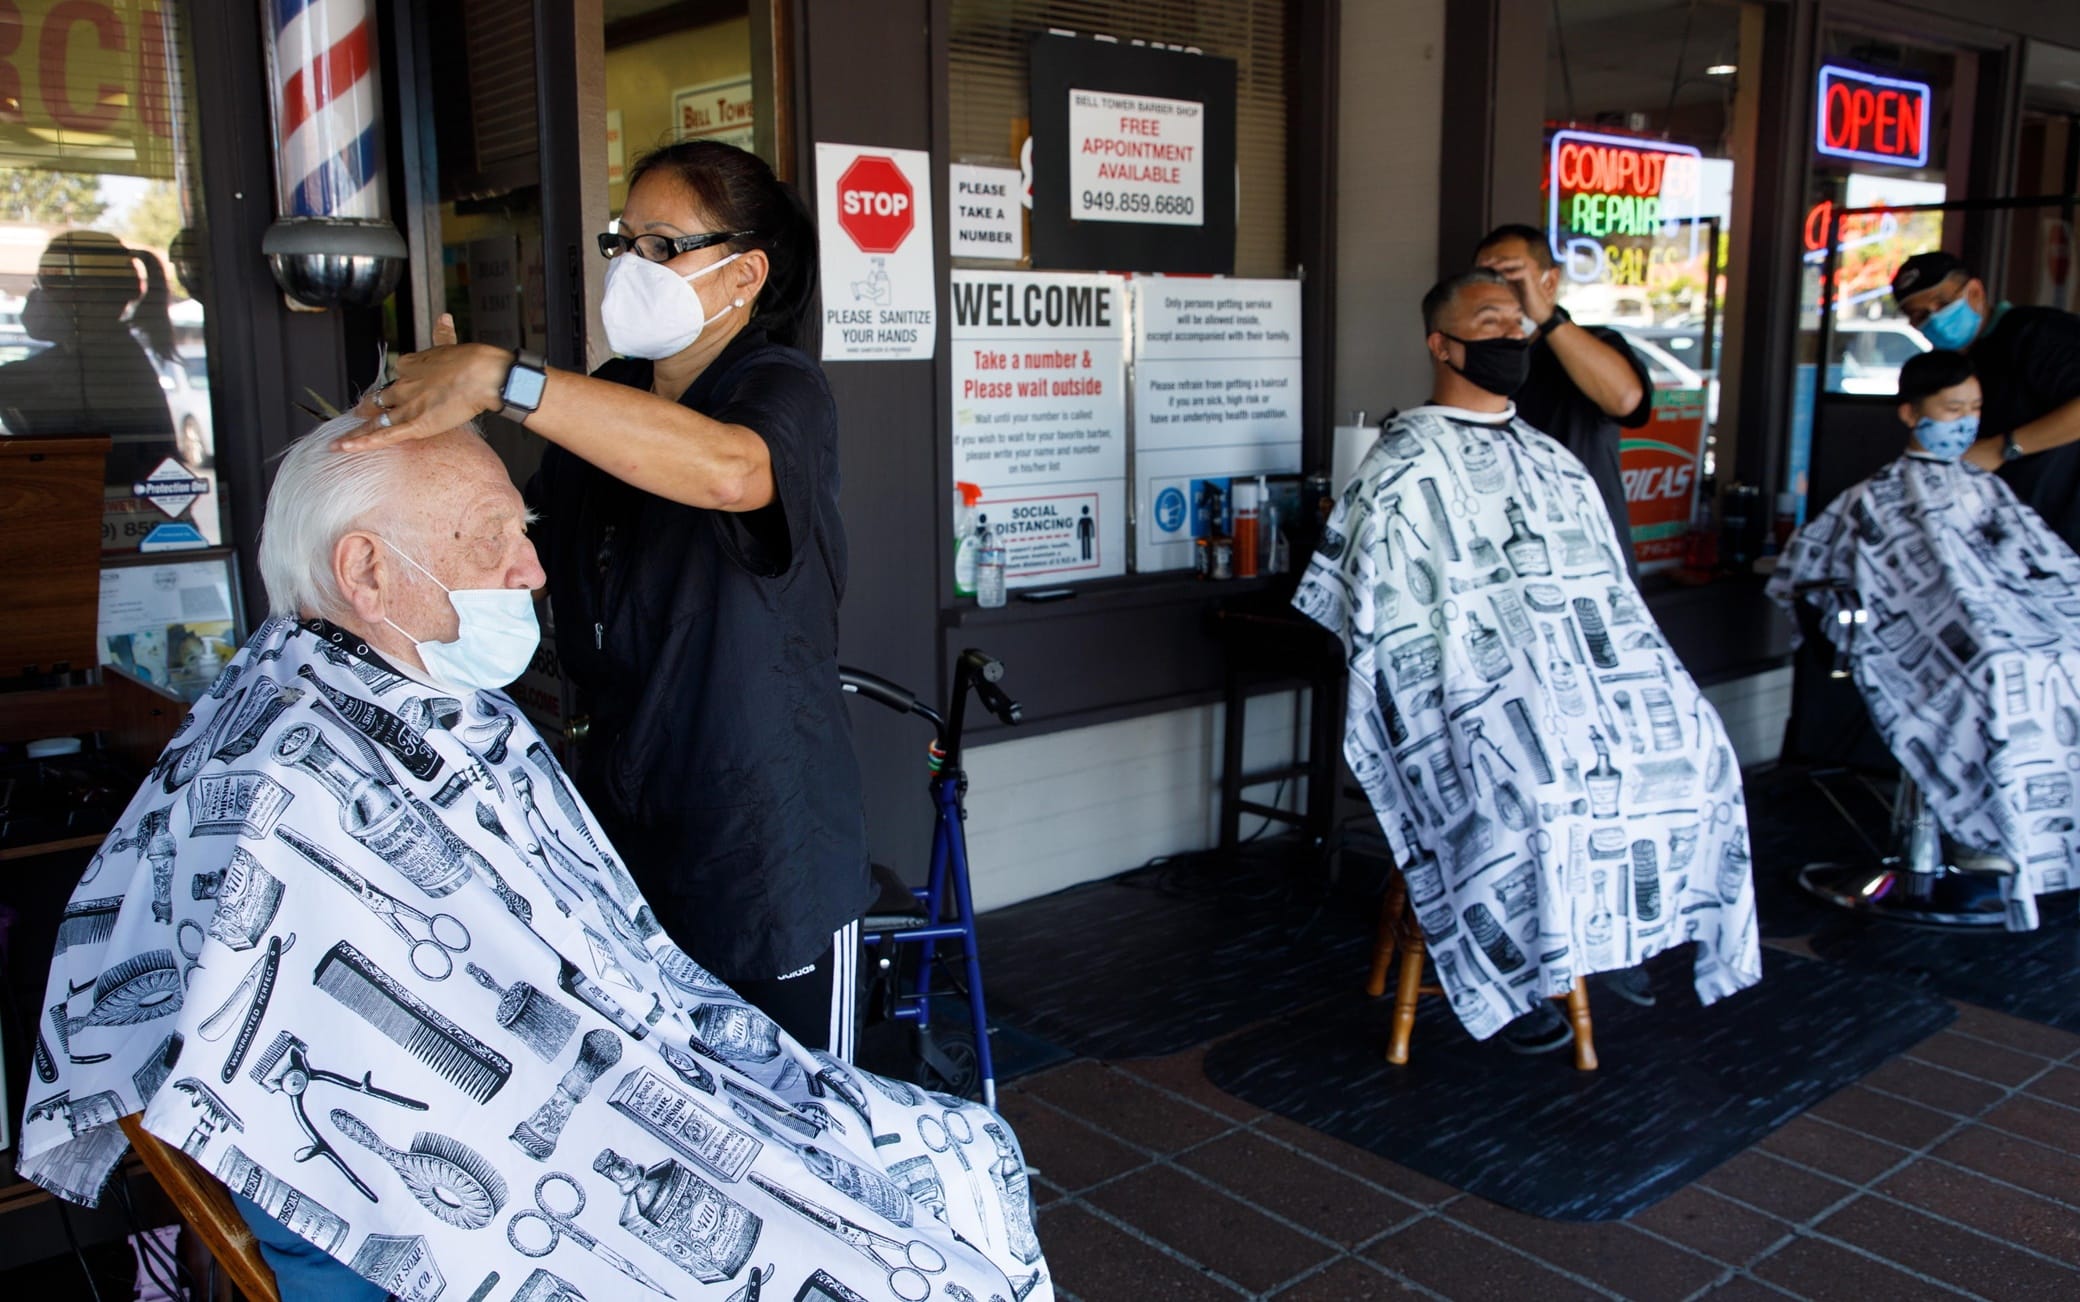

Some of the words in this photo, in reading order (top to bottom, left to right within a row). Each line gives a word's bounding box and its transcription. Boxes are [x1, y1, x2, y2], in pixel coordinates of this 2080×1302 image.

[1074, 94, 1099, 107] BELL
[1101, 98, 1136, 111] TOWER
[1138, 100, 1174, 114] BARBER
[1176, 103, 1199, 117] SHOP
[1120, 117, 1160, 136] FREE
[1825, 82, 1923, 155] OPEN
[1082, 138, 1195, 162] APPOINTMENT
[1098, 163, 1181, 184] AVAILABLE
[1559, 144, 1695, 198] COMPUTER
[959, 182, 1006, 196] PLEASE
[844, 190, 908, 217] STOP
[959, 206, 992, 219] TAKE
[996, 209, 1005, 219] A
[1082, 190, 1194, 216] 949.859.6680
[1572, 193, 1661, 238] REPAIR
[959, 230, 1013, 244] NUMBER
[1603, 245, 1679, 287] SALES
[953, 282, 1111, 328] WELCOME
[827, 309, 872, 325] PLEASE
[880, 310, 931, 325] SANITIZE
[842, 329, 873, 344] YOUR
[878, 329, 917, 344] HANDS
[974, 350, 1006, 370] Take
[1012, 353, 1020, 369] a
[1024, 350, 1078, 369] number
[1082, 350, 1092, 369] &
[964, 379, 1013, 399] Please
[1017, 378, 1048, 397] wait
[1052, 377, 1103, 396] outside
[146, 481, 190, 494] Protection
[1012, 505, 1058, 519] SOCIAL
[995, 517, 1074, 536] DISTANCING
[230, 1009, 260, 1067] WARRANTED
